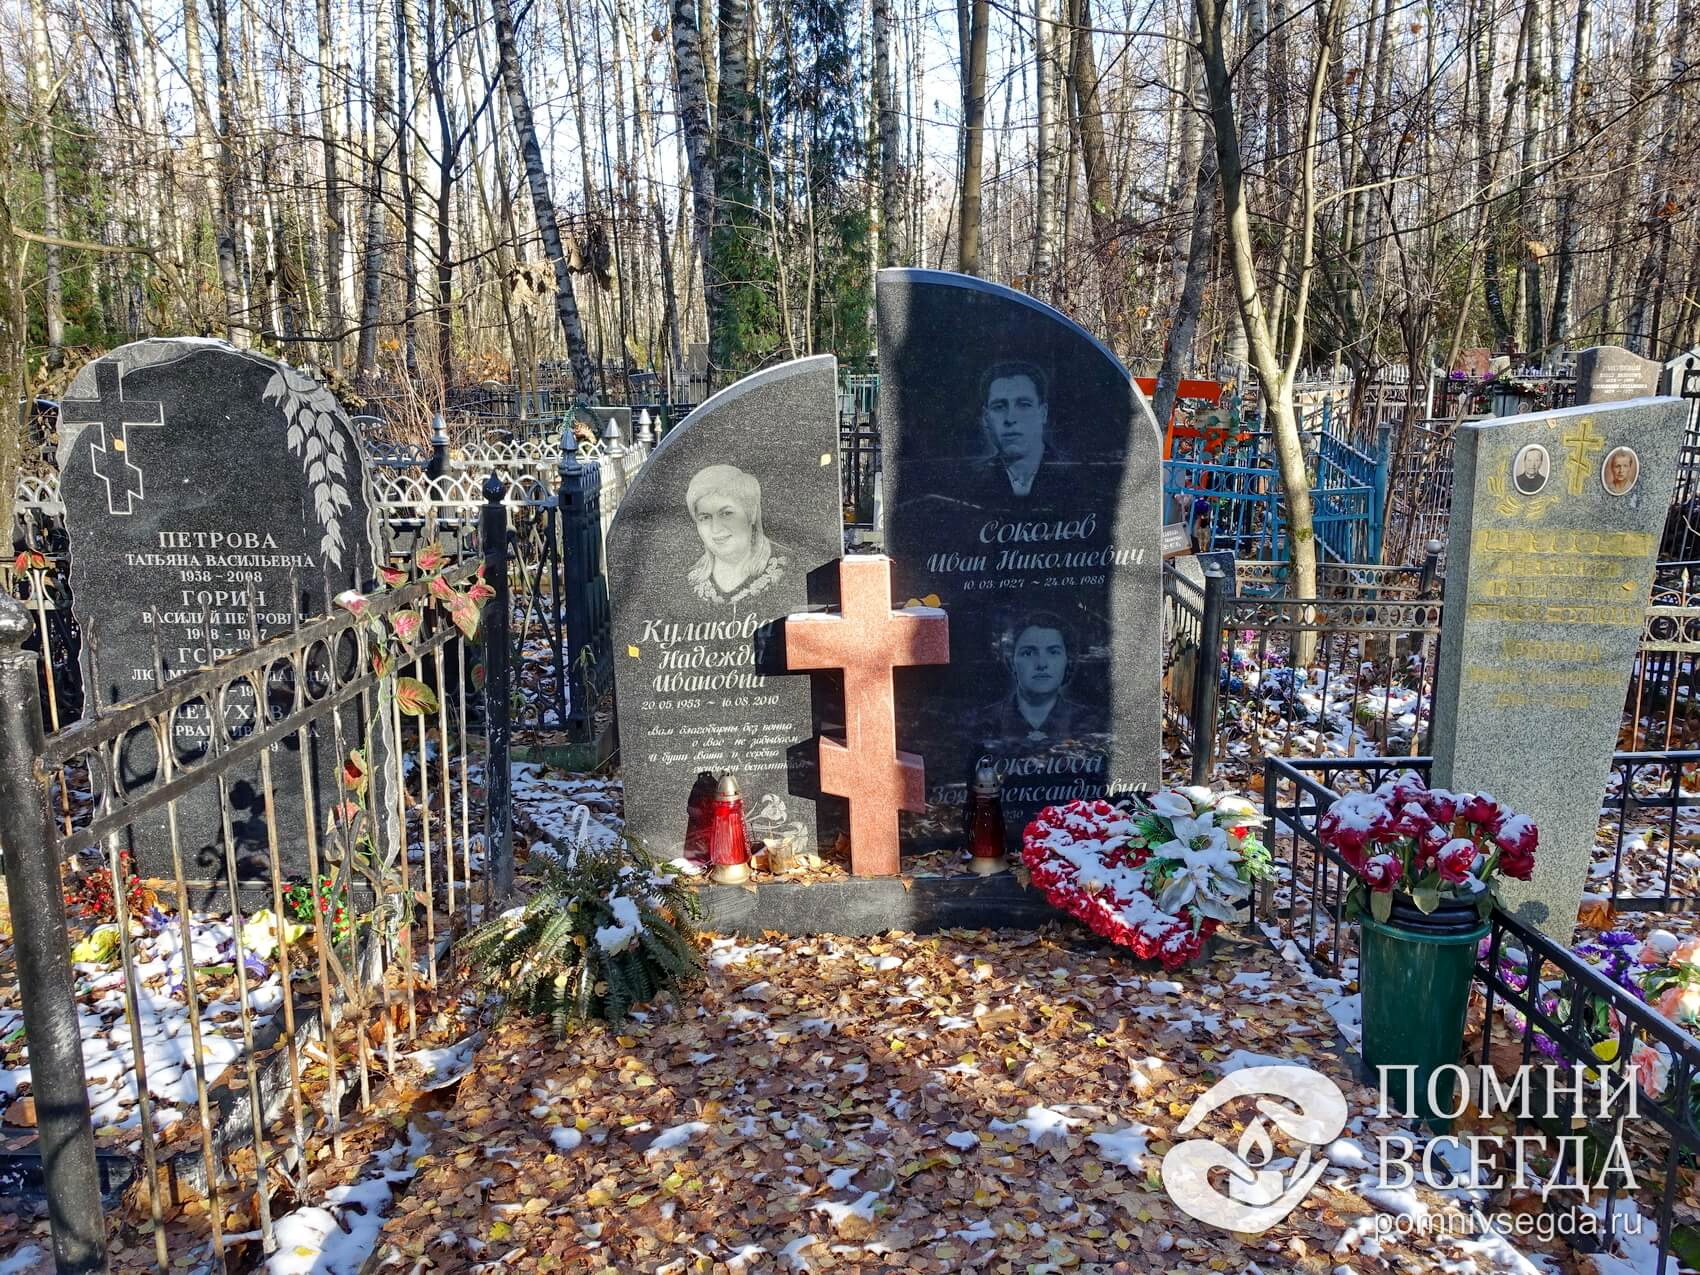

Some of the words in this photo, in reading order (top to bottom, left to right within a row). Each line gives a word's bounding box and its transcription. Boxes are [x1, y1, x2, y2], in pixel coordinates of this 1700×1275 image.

[979, 512, 1097, 543] Соколов
[158, 531, 280, 549] ПЕТРОВА
[125, 554, 201, 567] ТАТЬЯНА
[206, 554, 316, 568] ВАСИЛЬЕВНА
[927, 551, 986, 573] Иван
[996, 545, 1145, 571] Николаевич
[180, 570, 211, 582] 1958
[227, 570, 263, 583] 2008
[186, 628, 220, 640] 198
[237, 628, 268, 641] 197
[636, 613, 775, 649] Кулакова
[659, 645, 764, 670] Надежда
[653, 670, 766, 692] Ивановна
[1000, 778, 1148, 802] лександровна
